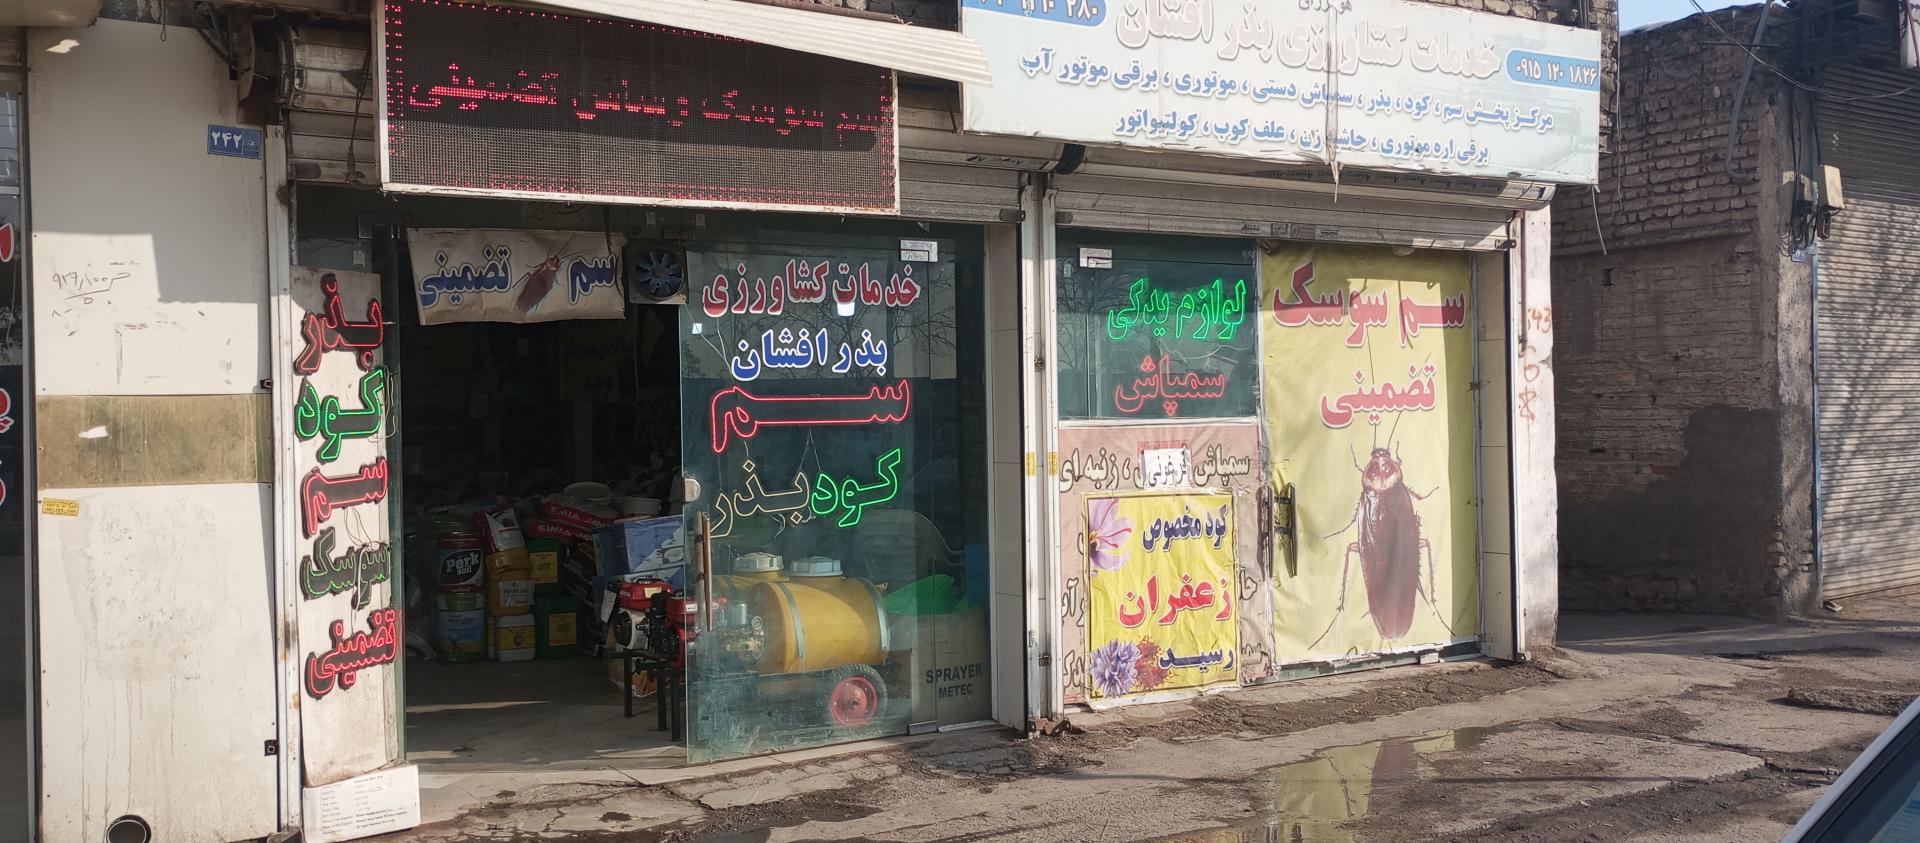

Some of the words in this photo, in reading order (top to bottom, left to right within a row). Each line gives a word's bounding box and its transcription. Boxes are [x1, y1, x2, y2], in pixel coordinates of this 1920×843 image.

[1217, 2, 1274, 63] بذر
[1410, 31, 1503, 79] خدمات
[1021, 48, 1053, 72] آب
[1058, 56, 1108, 83] موتور
[1114, 61, 1158, 90] برقی
[1175, 70, 1238, 95] موتوری
[409, 63, 560, 111] تضمینی
[1252, 79, 1298, 99] دستی
[1367, 88, 1392, 112] بذر
[1405, 95, 1431, 117] کود
[703, 90, 824, 136] سوسک
[1214, 118, 1249, 142] کوب
[1254, 120, 1285, 139] علف
[1443, 106, 1463, 119] سم
[1467, 101, 1511, 126] پخش
[1513, 107, 1554, 129] مرکز
[212, 131, 242, 149] ۲۴۲
[1380, 135, 1430, 155] موتوری
[1434, 138, 1454, 159] اره
[1456, 139, 1489, 162] برقی
[419, 246, 512, 308] تضمینی
[568, 253, 616, 305] سم
[702, 258, 830, 318] کشاورزی
[832, 262, 922, 307] خدمات
[297, 274, 385, 373] بذر
[1107, 278, 1171, 340] یدکی
[1175, 279, 1247, 340] لوازم
[1272, 261, 1390, 348] سوسک
[1399, 290, 1466, 348] سم
[731, 326, 828, 382] افشان
[831, 328, 889, 377] بذر
[1115, 355, 1226, 416] سمپاش
[1320, 362, 1436, 428] تضمینی
[295, 369, 385, 461] کود
[711, 378, 911, 454] سم
[811, 447, 901, 528] کود
[1194, 443, 1250, 487] سمپاش
[303, 458, 389, 536] سم
[709, 459, 810, 538] بذر
[1142, 505, 1202, 551] مخصوص
[1206, 503, 1228, 549] کود
[303, 527, 391, 610] سوسک
[446, 552, 480, 574] Perk
[1119, 574, 1233, 628] زعفران
[307, 609, 396, 696] تضمینی
[925, 663, 983, 684] SPRAYER
[1158, 647, 1234, 673] رسید
[938, 683, 973, 700] METEC
